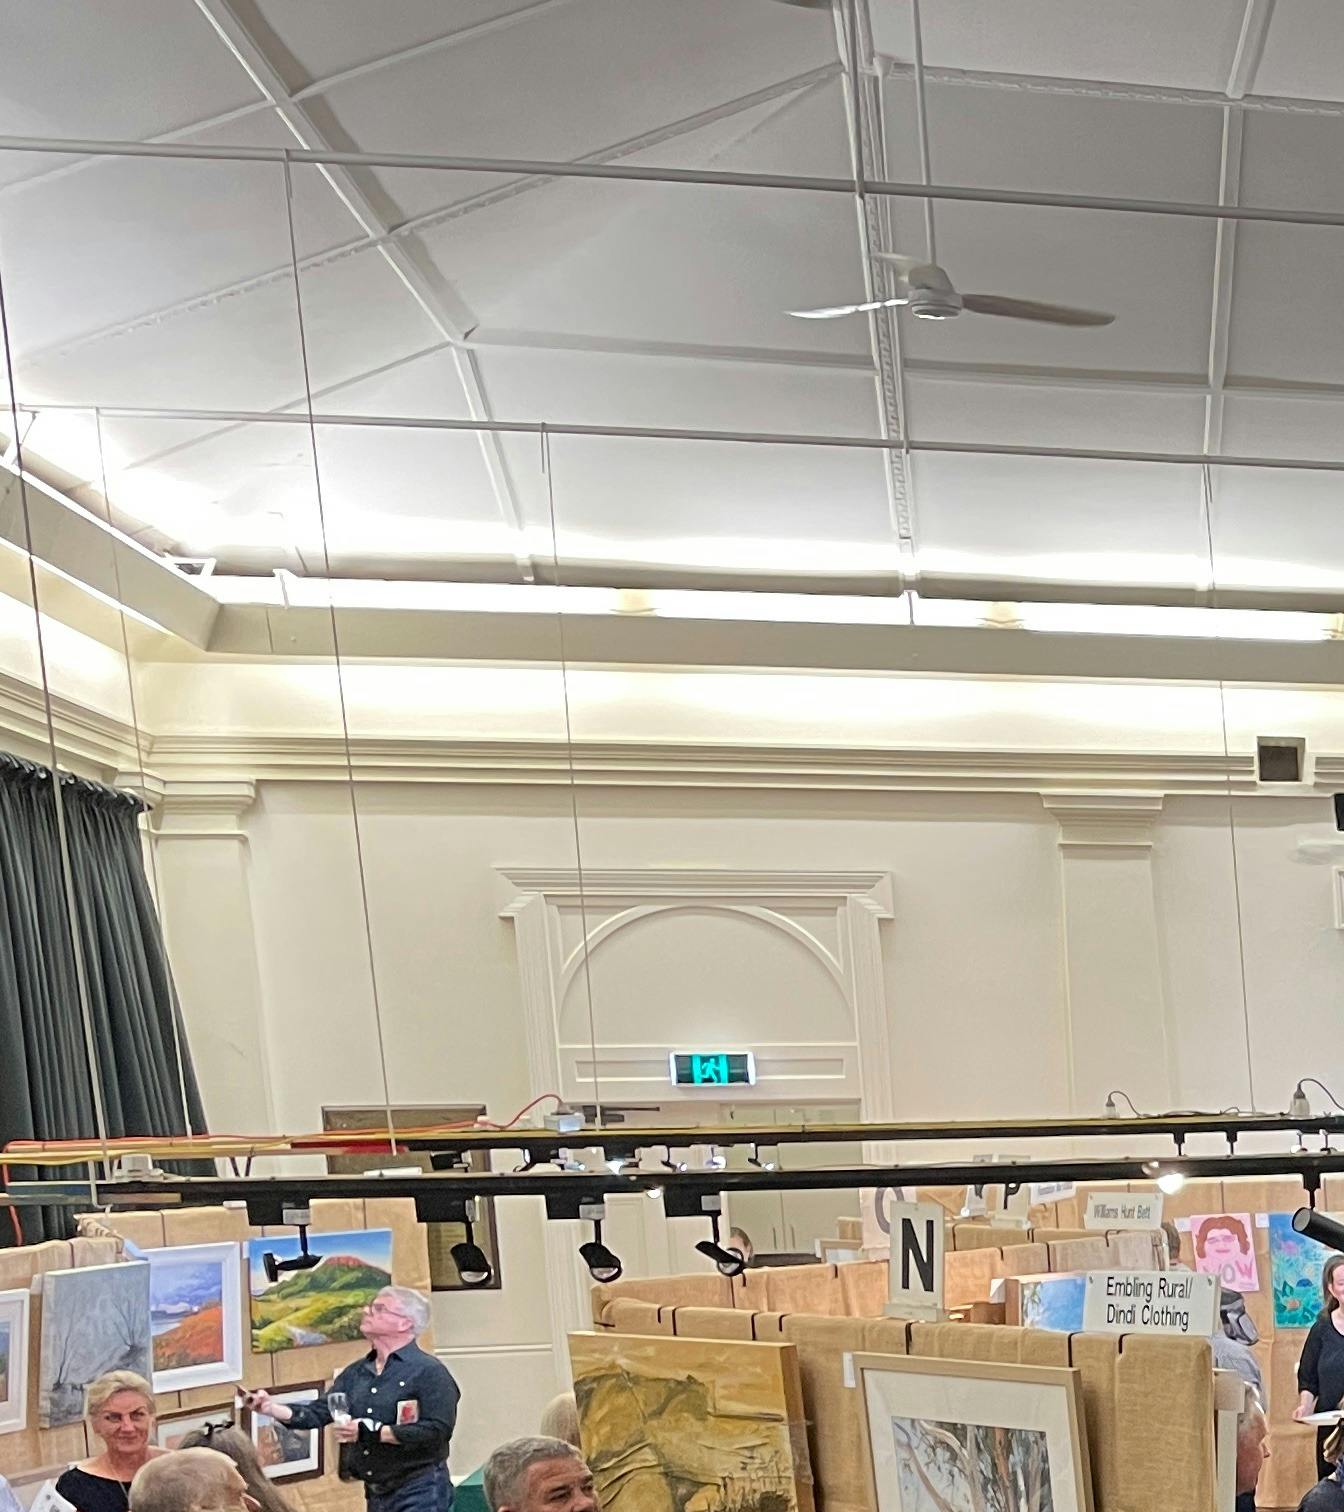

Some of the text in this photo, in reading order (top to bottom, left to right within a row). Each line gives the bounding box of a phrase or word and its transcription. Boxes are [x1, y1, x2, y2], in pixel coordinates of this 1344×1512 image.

[1094, 1203, 1119, 1219] Williams
[901, 1217, 935, 1293] N
[1106, 1276, 1194, 1303] Embling Rural/
[1106, 1303, 1190, 1333] Dindi Clothing
